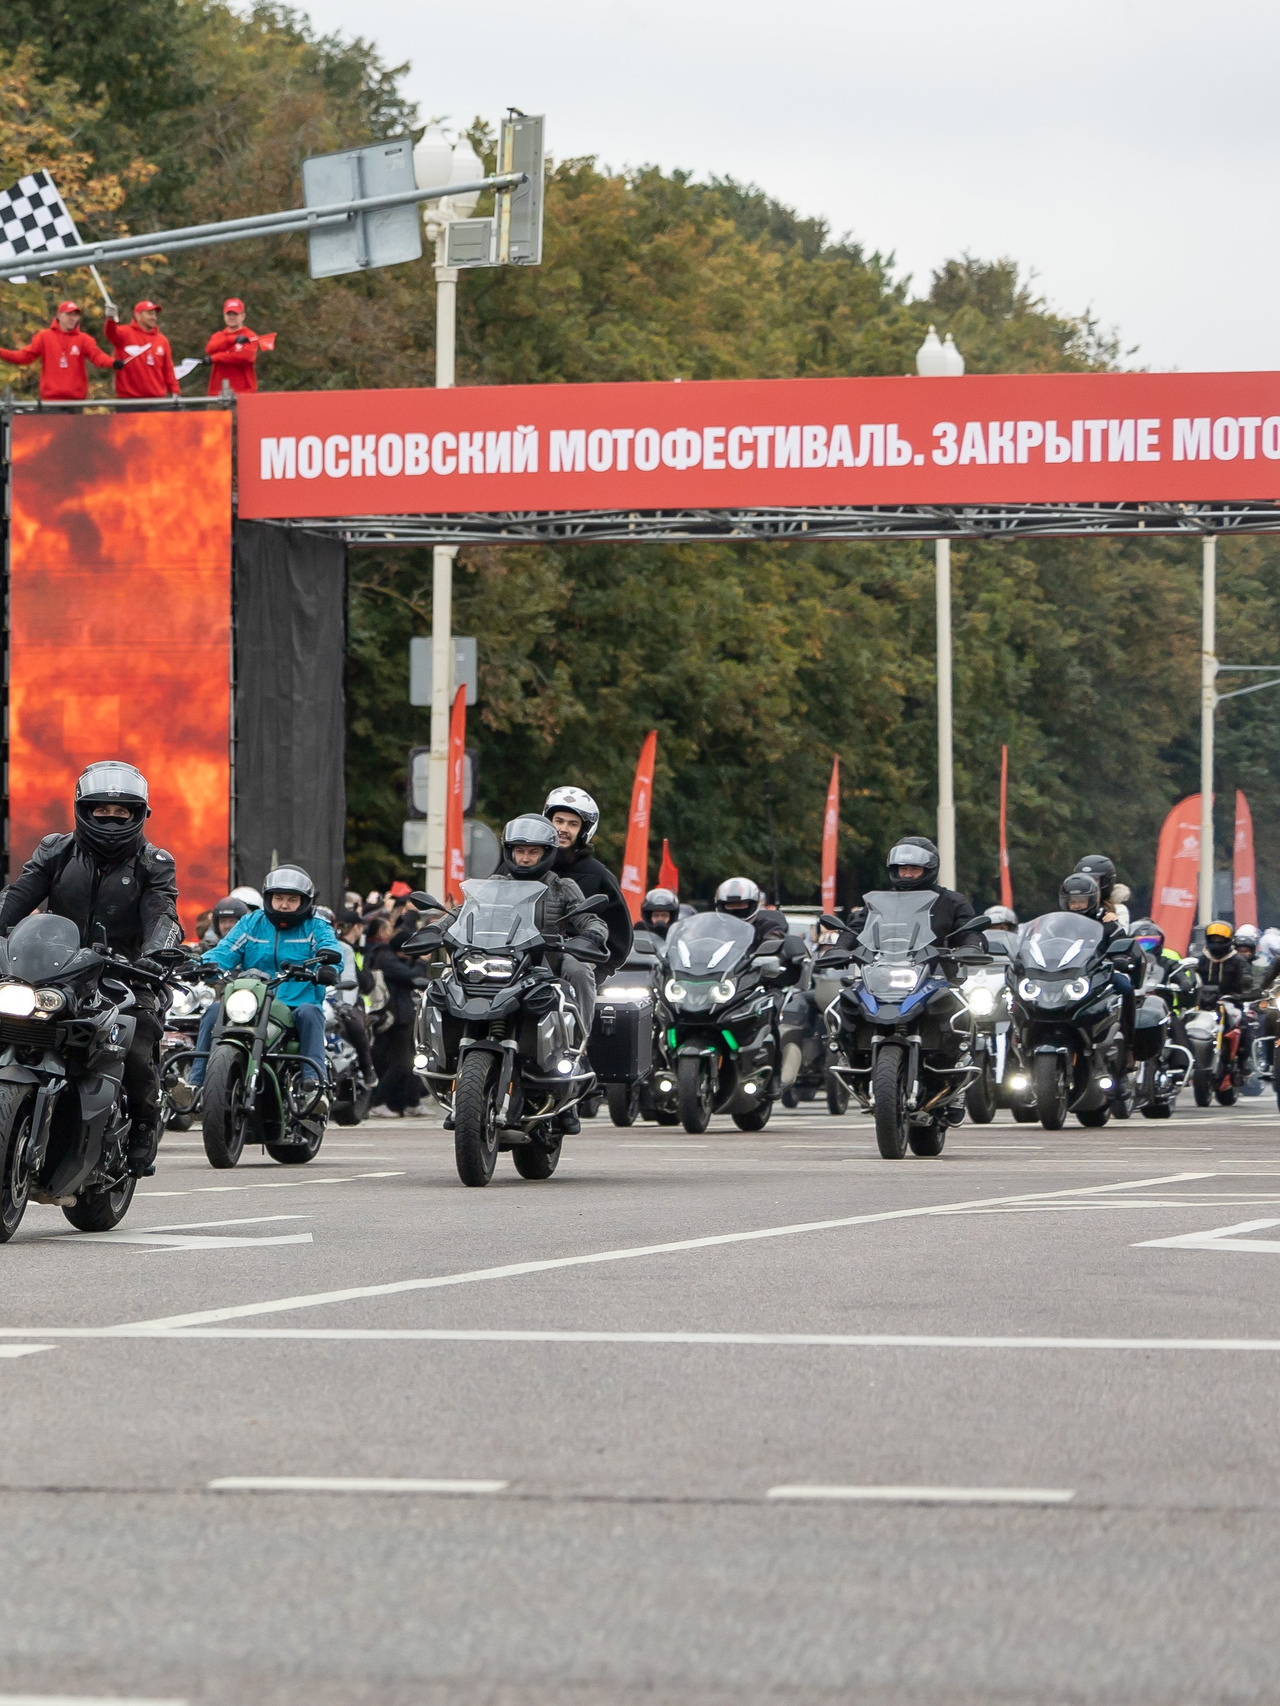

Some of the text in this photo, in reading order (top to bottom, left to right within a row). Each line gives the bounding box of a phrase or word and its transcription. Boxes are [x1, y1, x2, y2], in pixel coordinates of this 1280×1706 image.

[260, 415, 1280, 480] МОСКОВСКИЙ МОТОФЕСТИВАЛЬ. ЗАКРЫТИЕ МОТО
